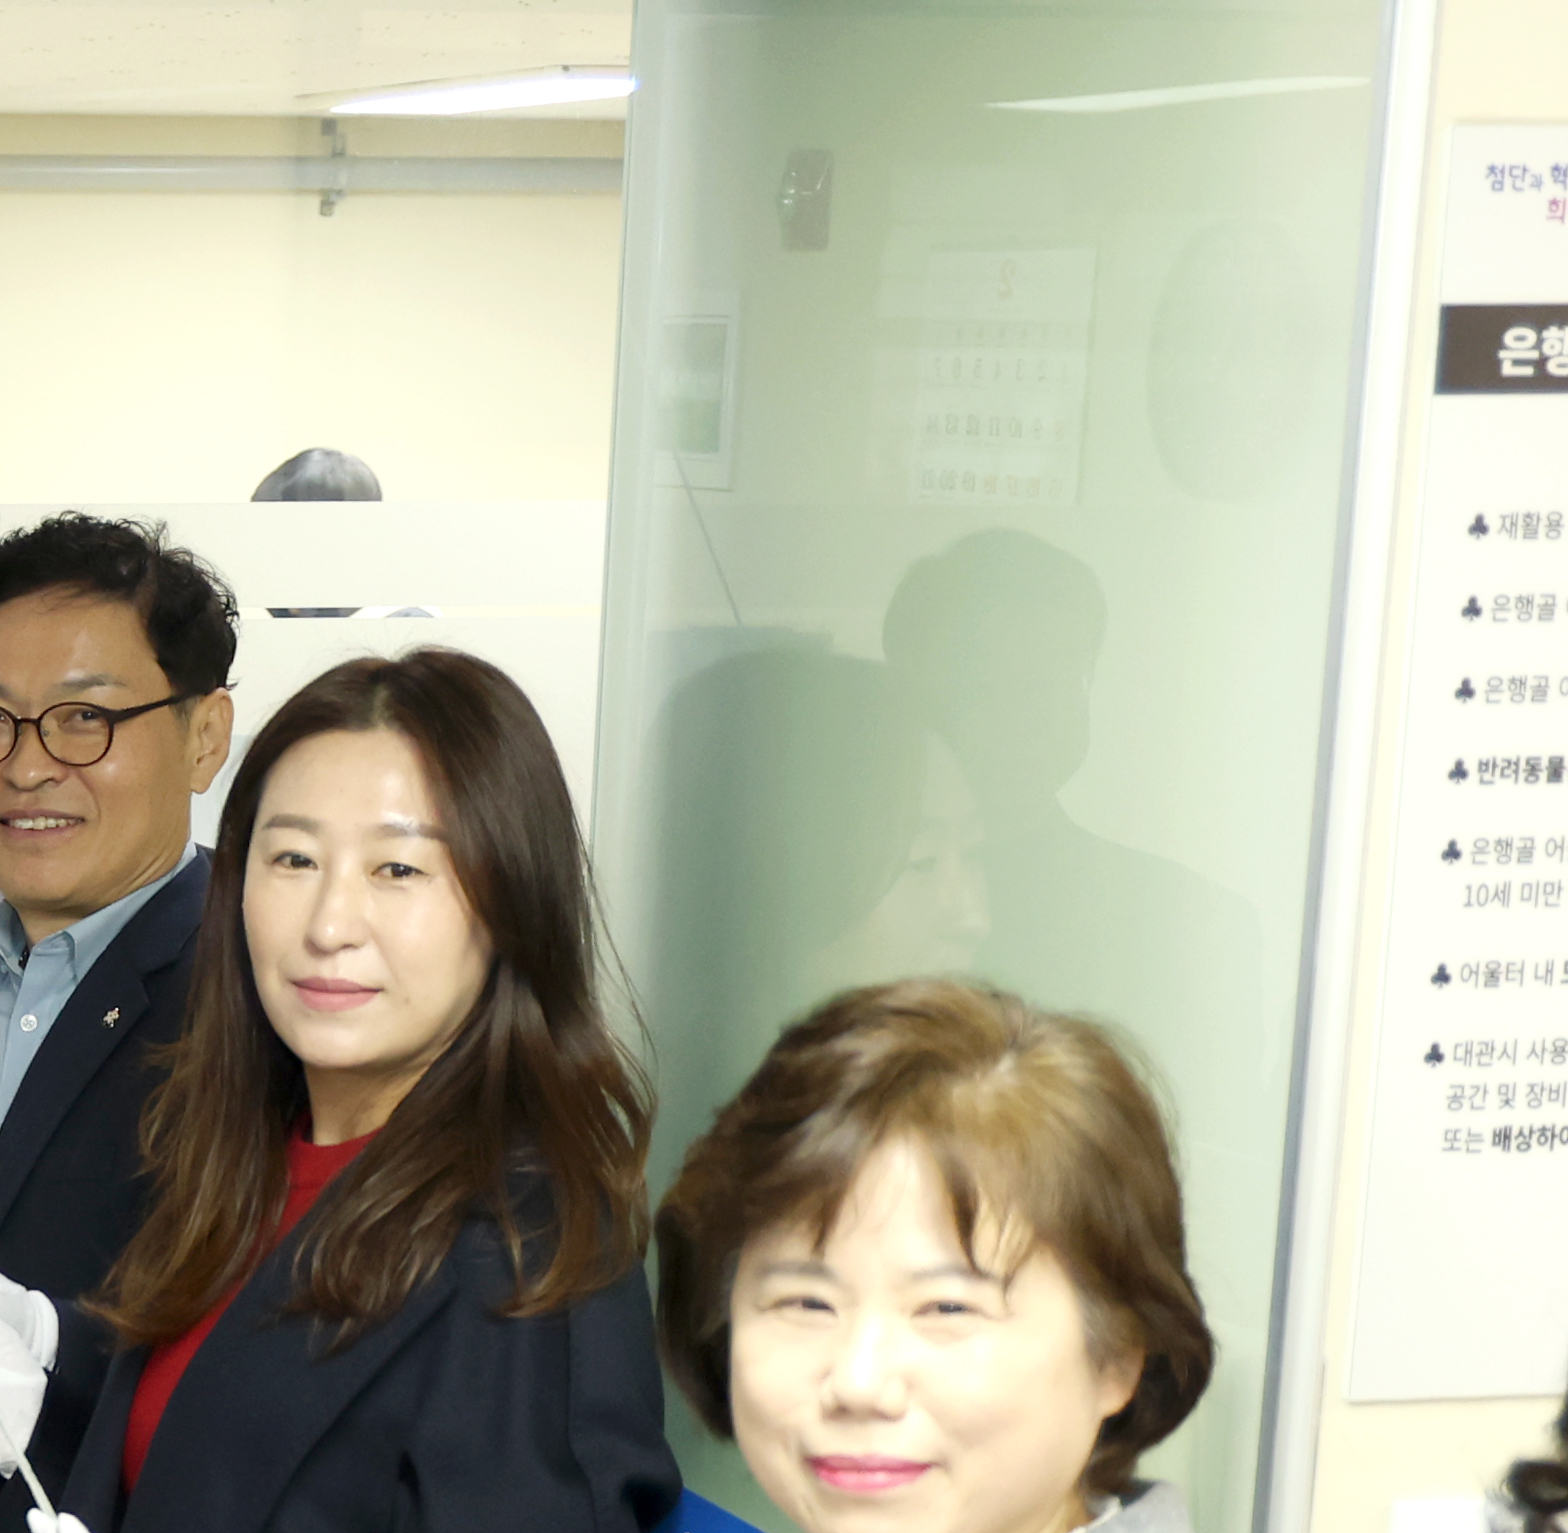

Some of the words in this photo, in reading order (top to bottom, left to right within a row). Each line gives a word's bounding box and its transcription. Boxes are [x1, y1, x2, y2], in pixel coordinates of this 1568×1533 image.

[1486, 163, 1544, 192] 첨단과
[1497, 511, 1565, 541] 재활용
[1491, 593, 1558, 623] 은행골
[1484, 675, 1551, 704] 은행골
[1470, 836, 1536, 865] 은행골
[1463, 880, 1512, 908] 10세
[1520, 879, 1564, 908] 미만
[1460, 959, 1525, 988] 어울터
[1534, 958, 1555, 987] 내
[1452, 1038, 1518, 1068] 대관시
[1526, 1037, 1568, 1066] 사용
[1446, 1082, 1489, 1111] 공간
[1497, 1081, 1517, 1110] 및
[1525, 1081, 1567, 1108] 장비
[1441, 1126, 1485, 1154] 또는
